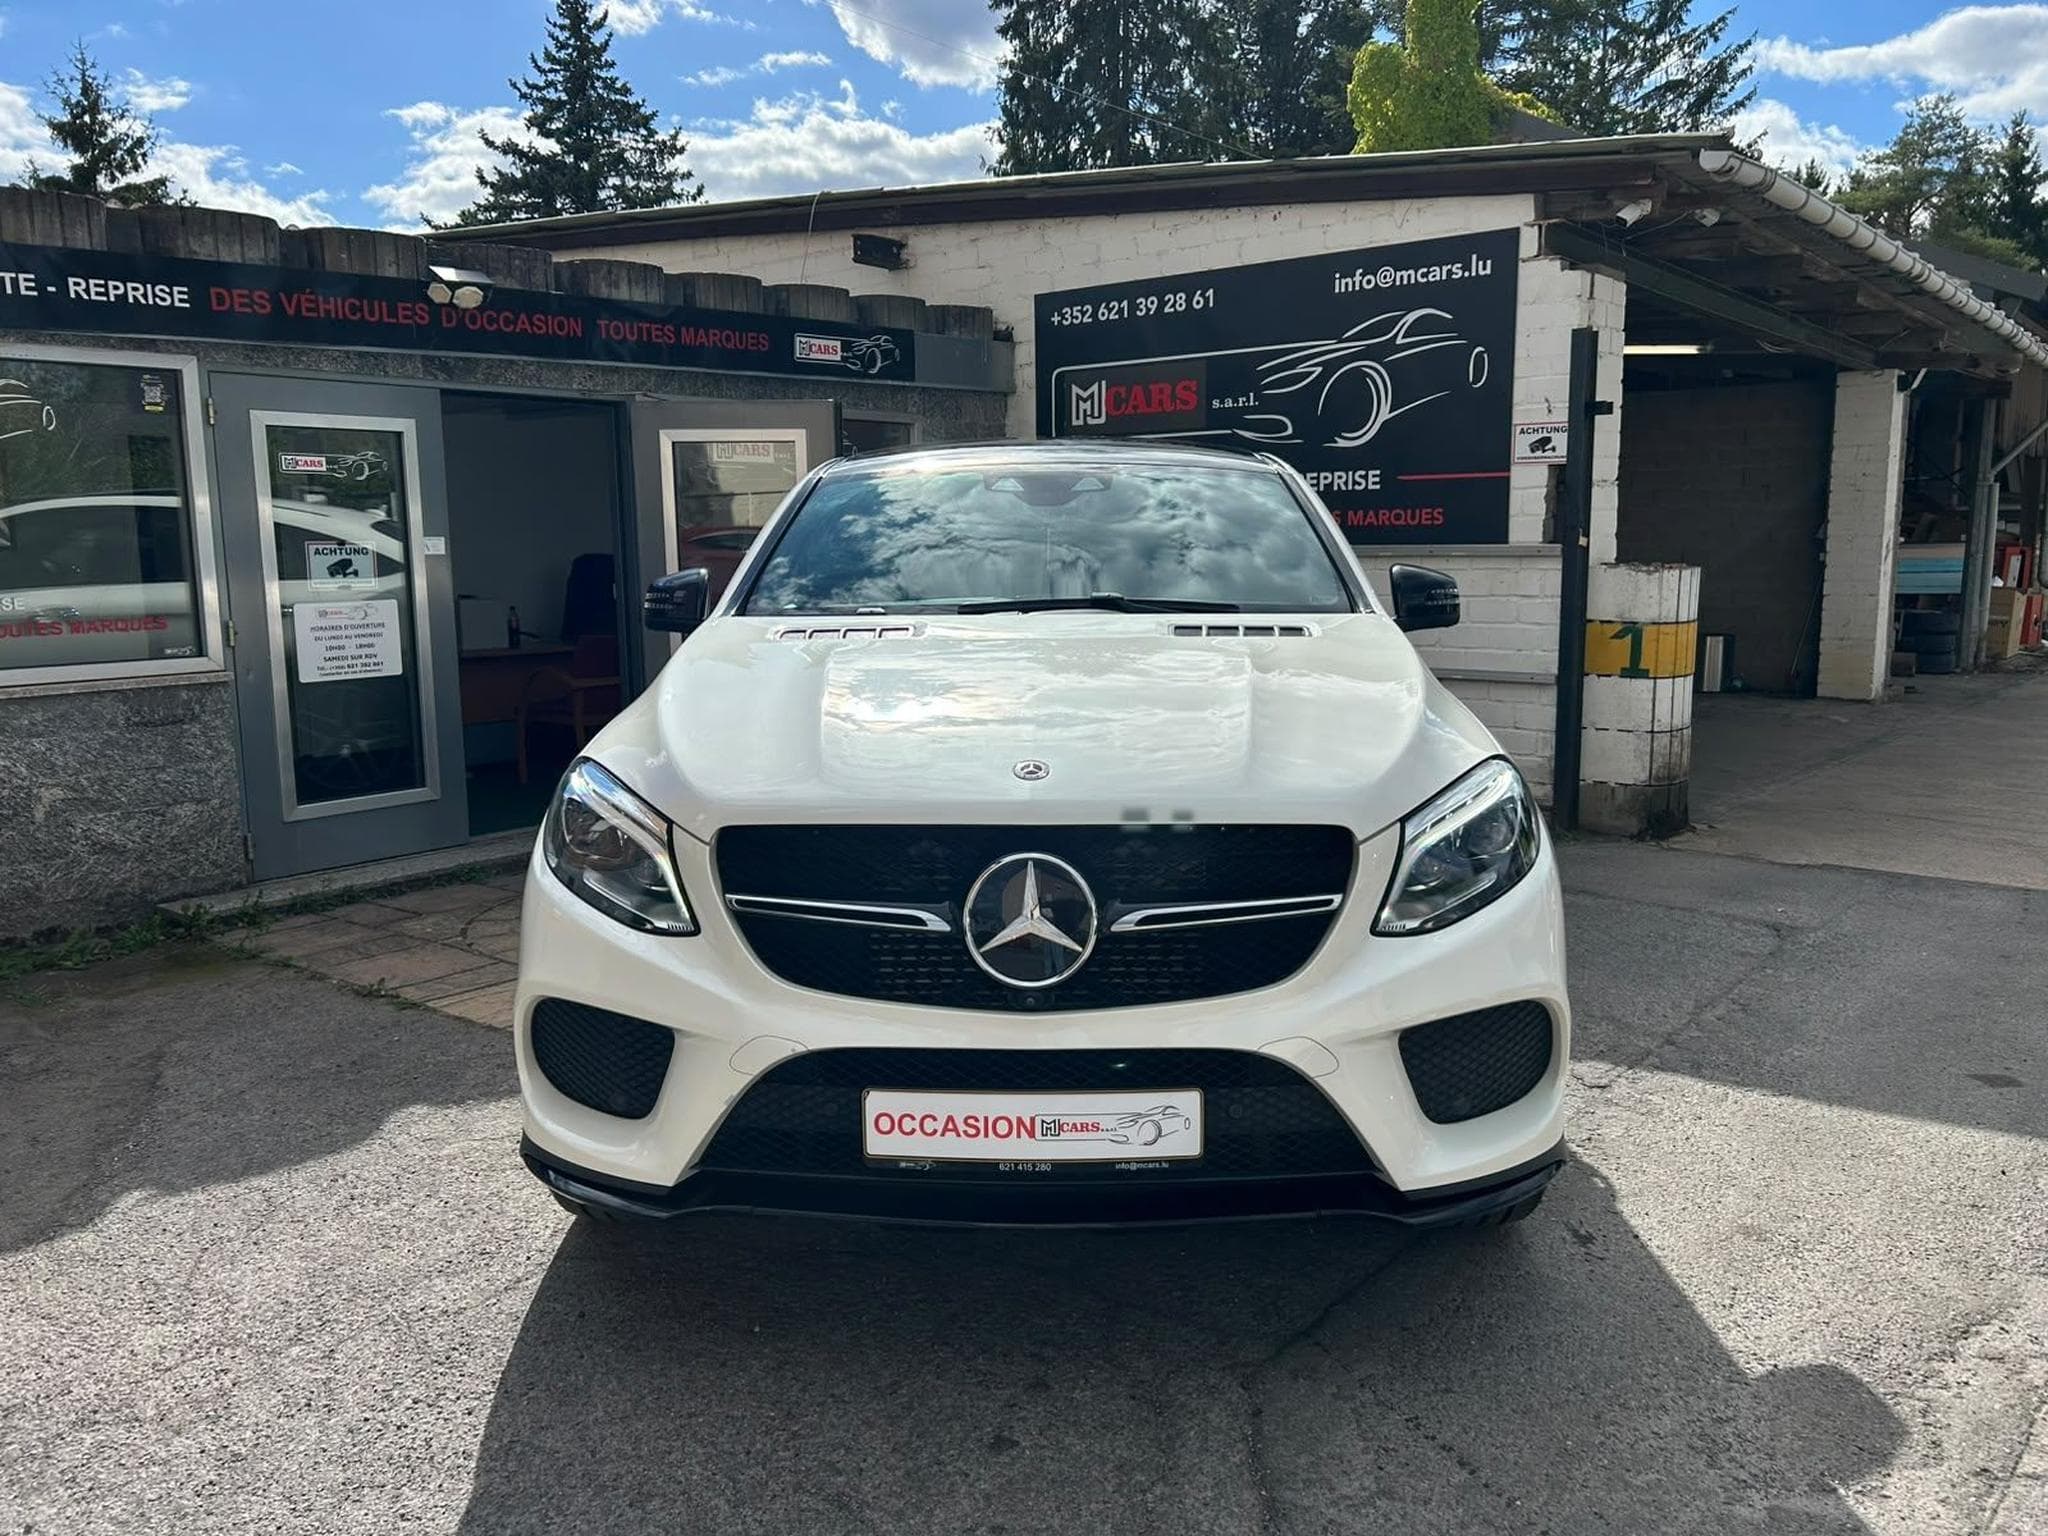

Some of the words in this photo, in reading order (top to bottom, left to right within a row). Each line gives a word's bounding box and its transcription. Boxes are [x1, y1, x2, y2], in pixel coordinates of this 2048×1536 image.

[1333, 254, 1493, 294] info@mcars.lu
[67, 276, 191, 309] REPRISE
[209, 286, 273, 316] DES
[280, 287, 431, 327] VÉHICULES
[440, 308, 583, 338] D'OCCASION
[598, 319, 677, 345] TOUTES
[680, 325, 770, 353] MARQUES
[1050, 303, 1094, 327] +352
[1097, 300, 1131, 323] 621
[1135, 295, 1159, 318] 39
[1163, 291, 1188, 314] 28
[1192, 288, 1216, 310] 61
[1211, 392, 1260, 409] s.a.r.l.
[1518, 425, 1568, 436] ACHTUNG
[1300, 470, 1381, 492] EPRISE
[1347, 508, 1445, 526] MARQUES
[313, 546, 370, 557] ACHTUNG
[71, 616, 169, 635] MARQUES
[1609, 622, 1651, 680] 1
[873, 1111, 1036, 1140] OCCASION
